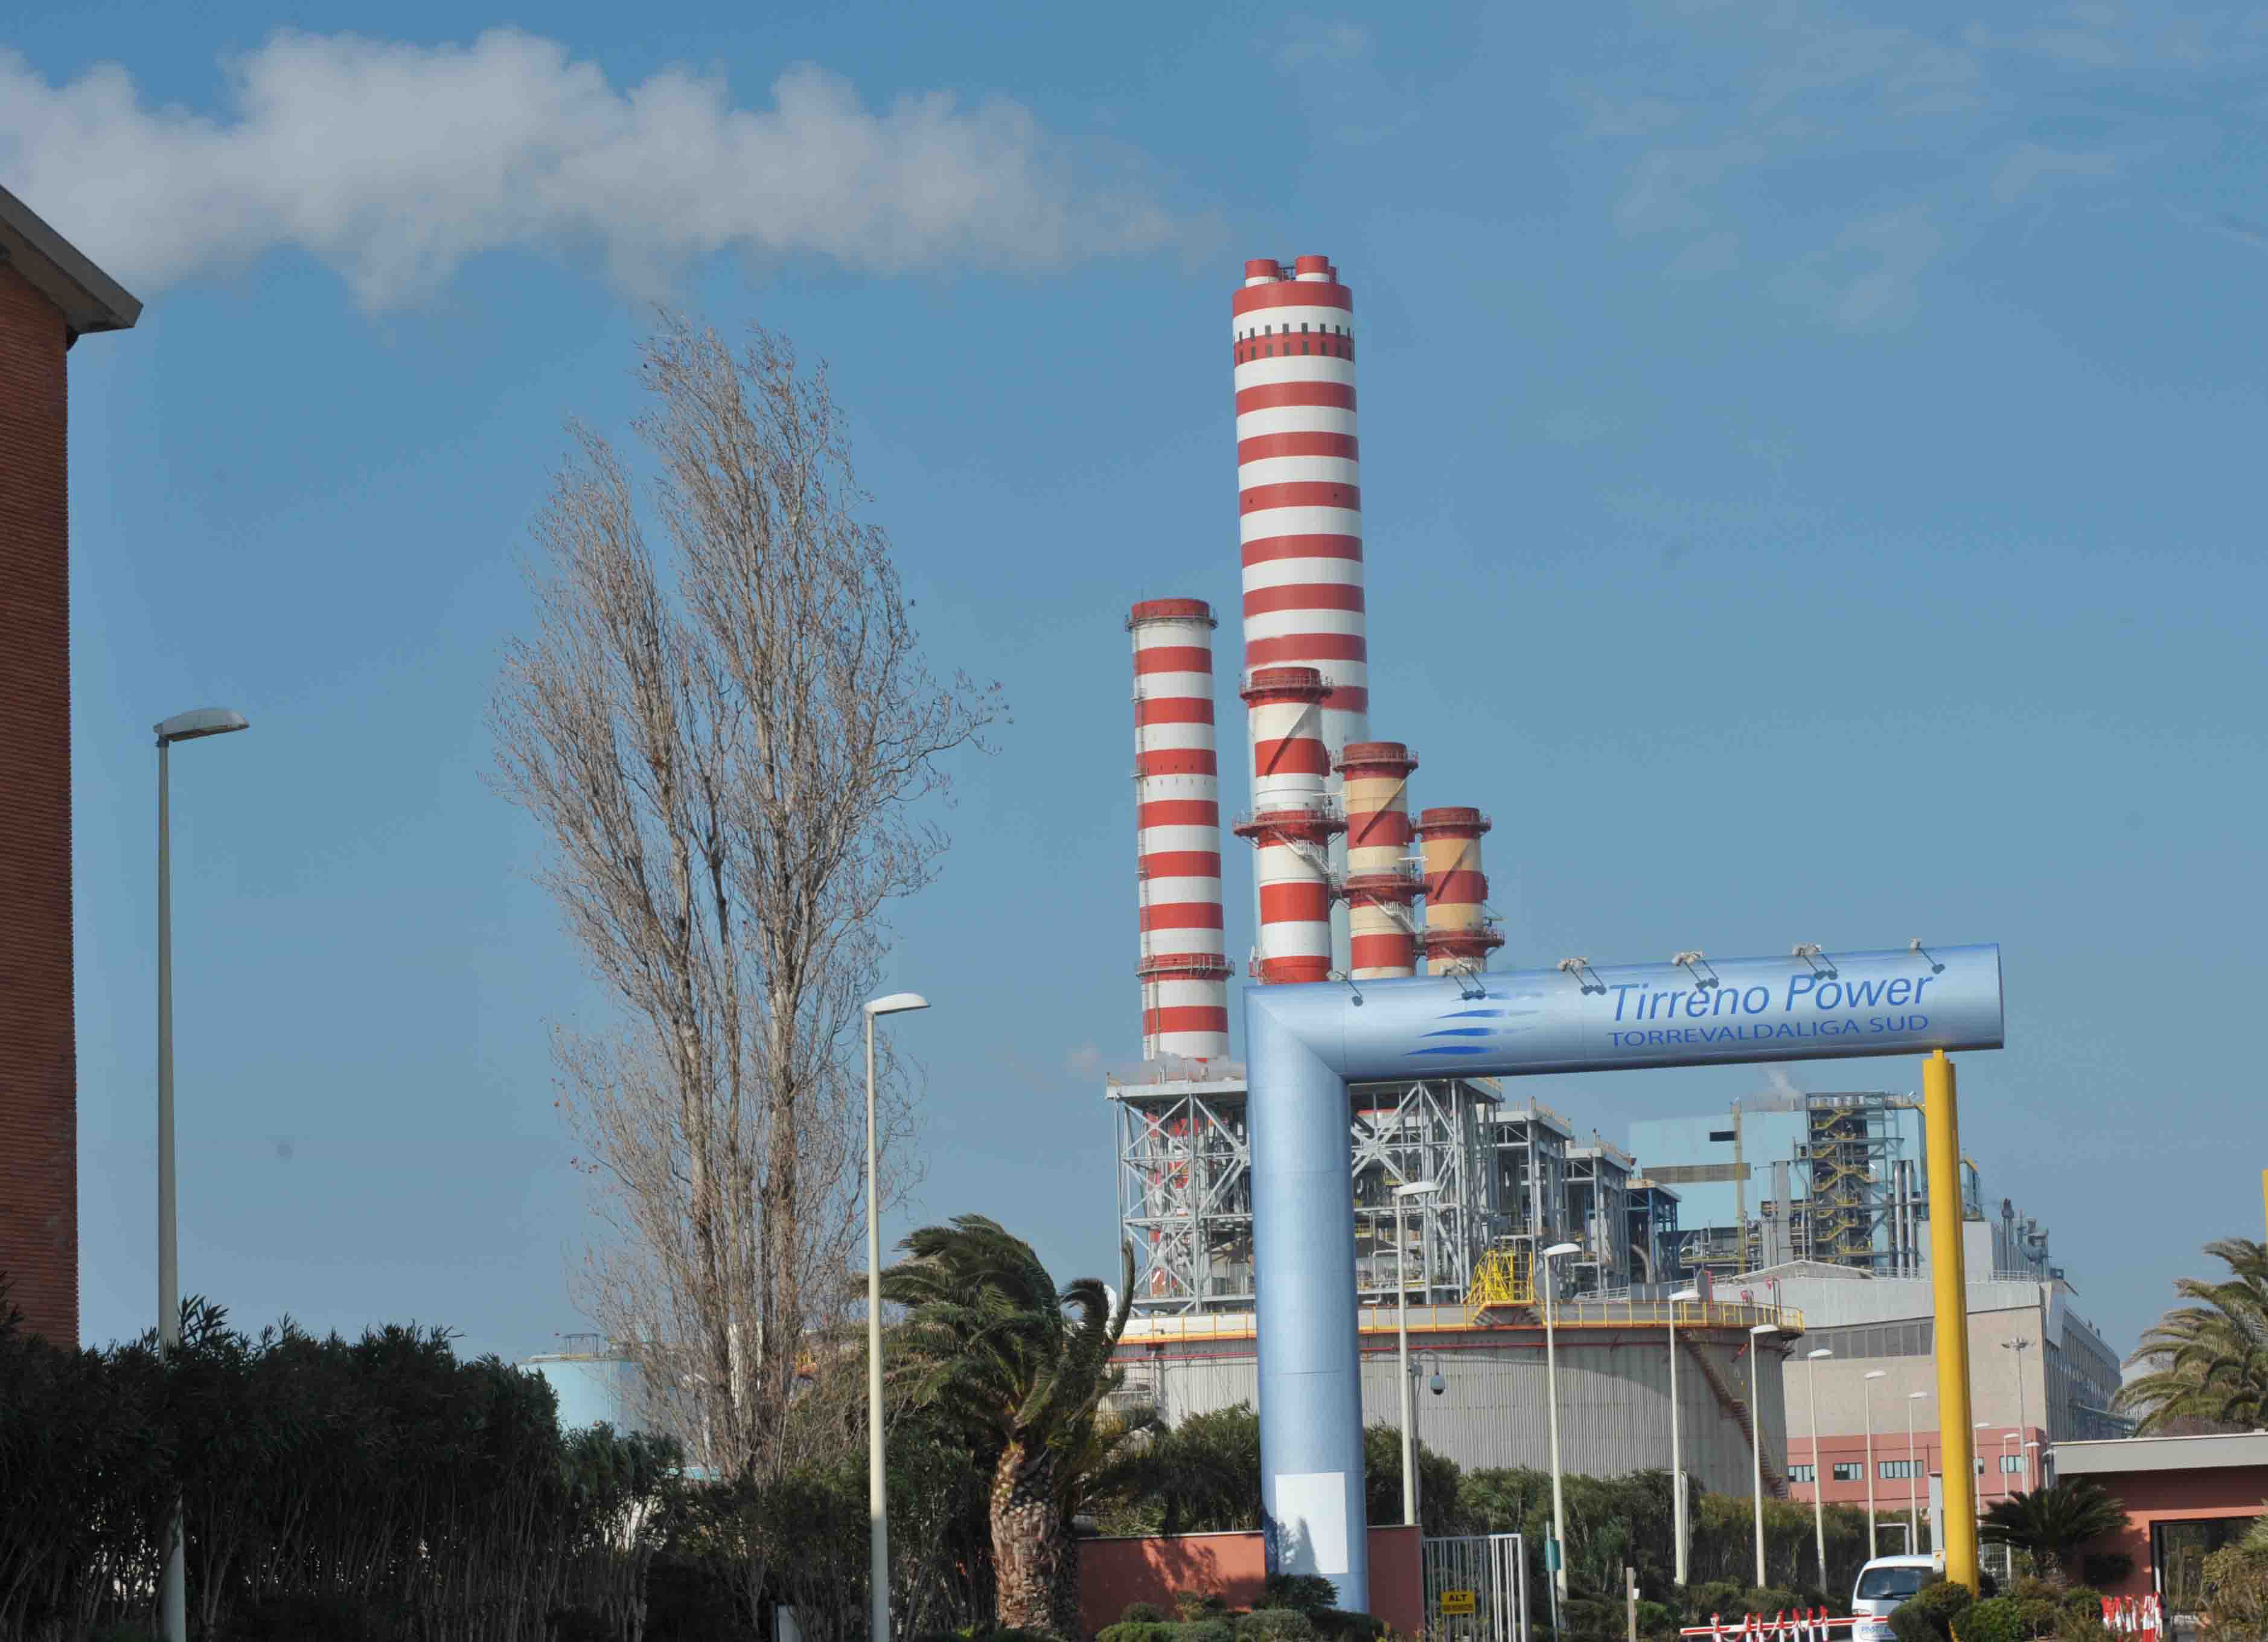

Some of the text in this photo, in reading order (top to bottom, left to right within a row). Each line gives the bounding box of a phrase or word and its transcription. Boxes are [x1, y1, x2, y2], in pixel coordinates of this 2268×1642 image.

[1609, 974, 1934, 1021] Tirreno Power
[1606, 1015, 1929, 1047] TORREVALDALIGA SUD
